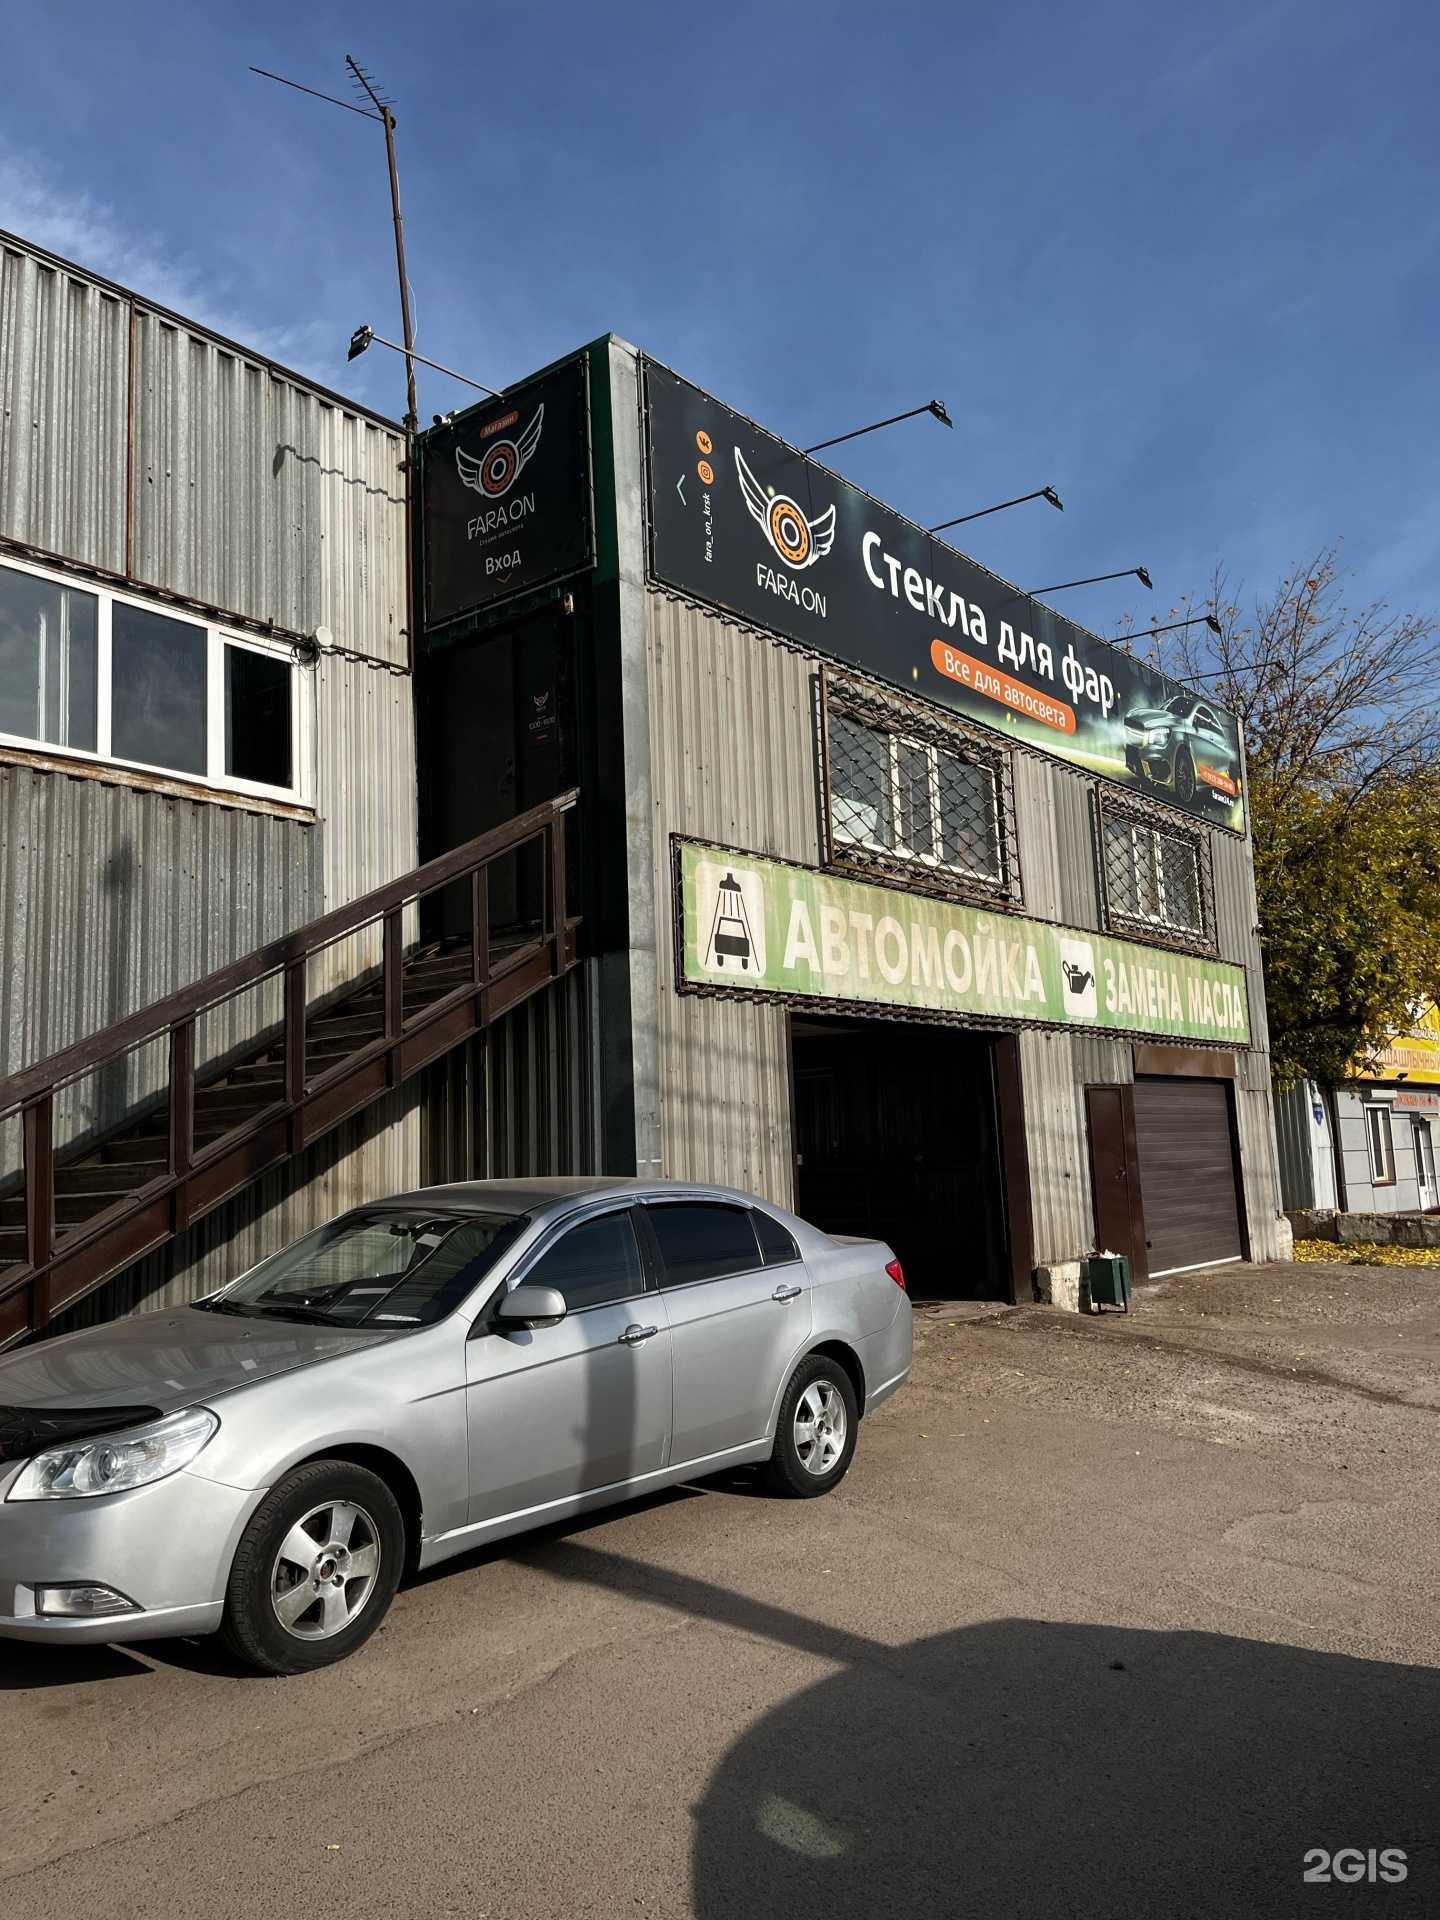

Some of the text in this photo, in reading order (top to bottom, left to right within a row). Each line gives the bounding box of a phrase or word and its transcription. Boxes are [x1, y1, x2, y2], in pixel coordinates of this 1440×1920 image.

[485, 550, 522, 575] Вход
[702, 492, 713, 563] fara_on_krsk
[862, 531, 1114, 719] Стекла для фар
[944, 650, 1066, 728] Все для автосвета
[782, 899, 1047, 1003] АВТОМОЙКА
[1103, 958, 1245, 1030] ЗАМЕНА МАСЛА
